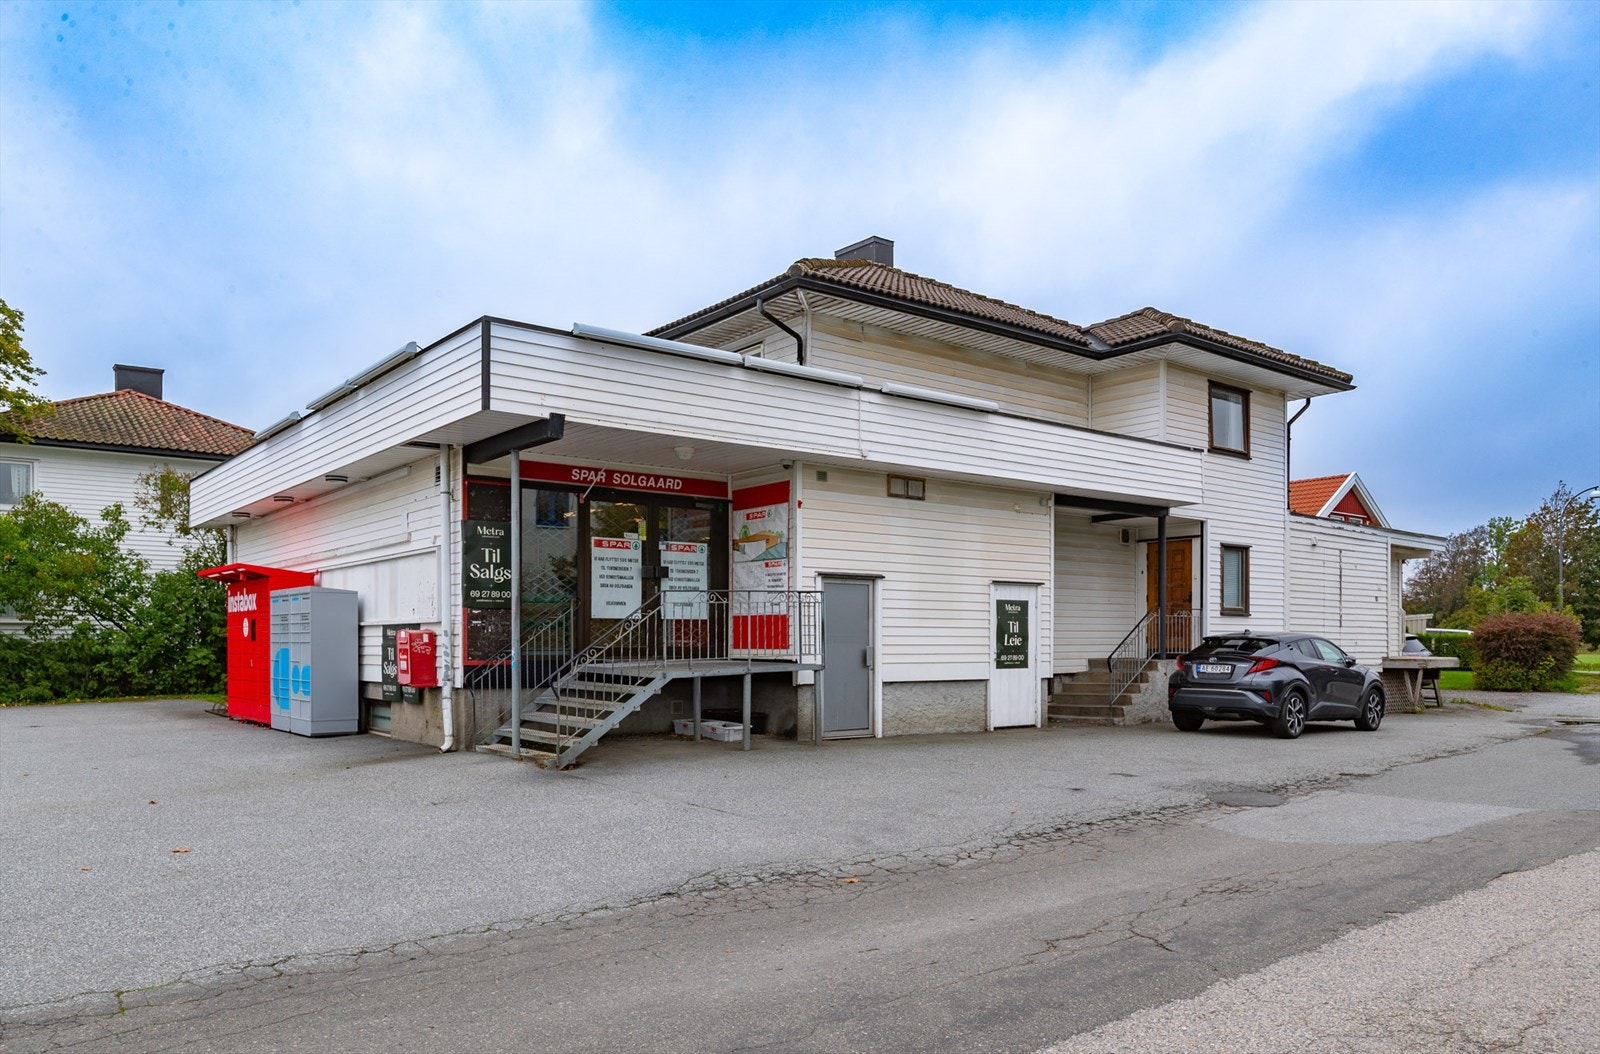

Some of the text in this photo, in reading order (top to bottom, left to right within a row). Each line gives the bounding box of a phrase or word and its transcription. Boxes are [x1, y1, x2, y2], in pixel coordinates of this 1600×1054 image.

[571, 468, 683, 490] SPAR SOLGAARD
[749, 510, 767, 520] SPAR
[476, 525, 505, 536] Metra
[602, 540, 632, 549] SPAR
[670, 544, 698, 553] SPAR
[481, 547, 500, 563] Til
[470, 563, 511, 583] Salgs
[481, 590, 490, 598] 27
[491, 590, 500, 598] 89
[227, 587, 257, 613] instabox
[1005, 604, 1021, 612] Metra
[1008, 621, 1019, 633] Til
[1004, 634, 1022, 646] Leie
